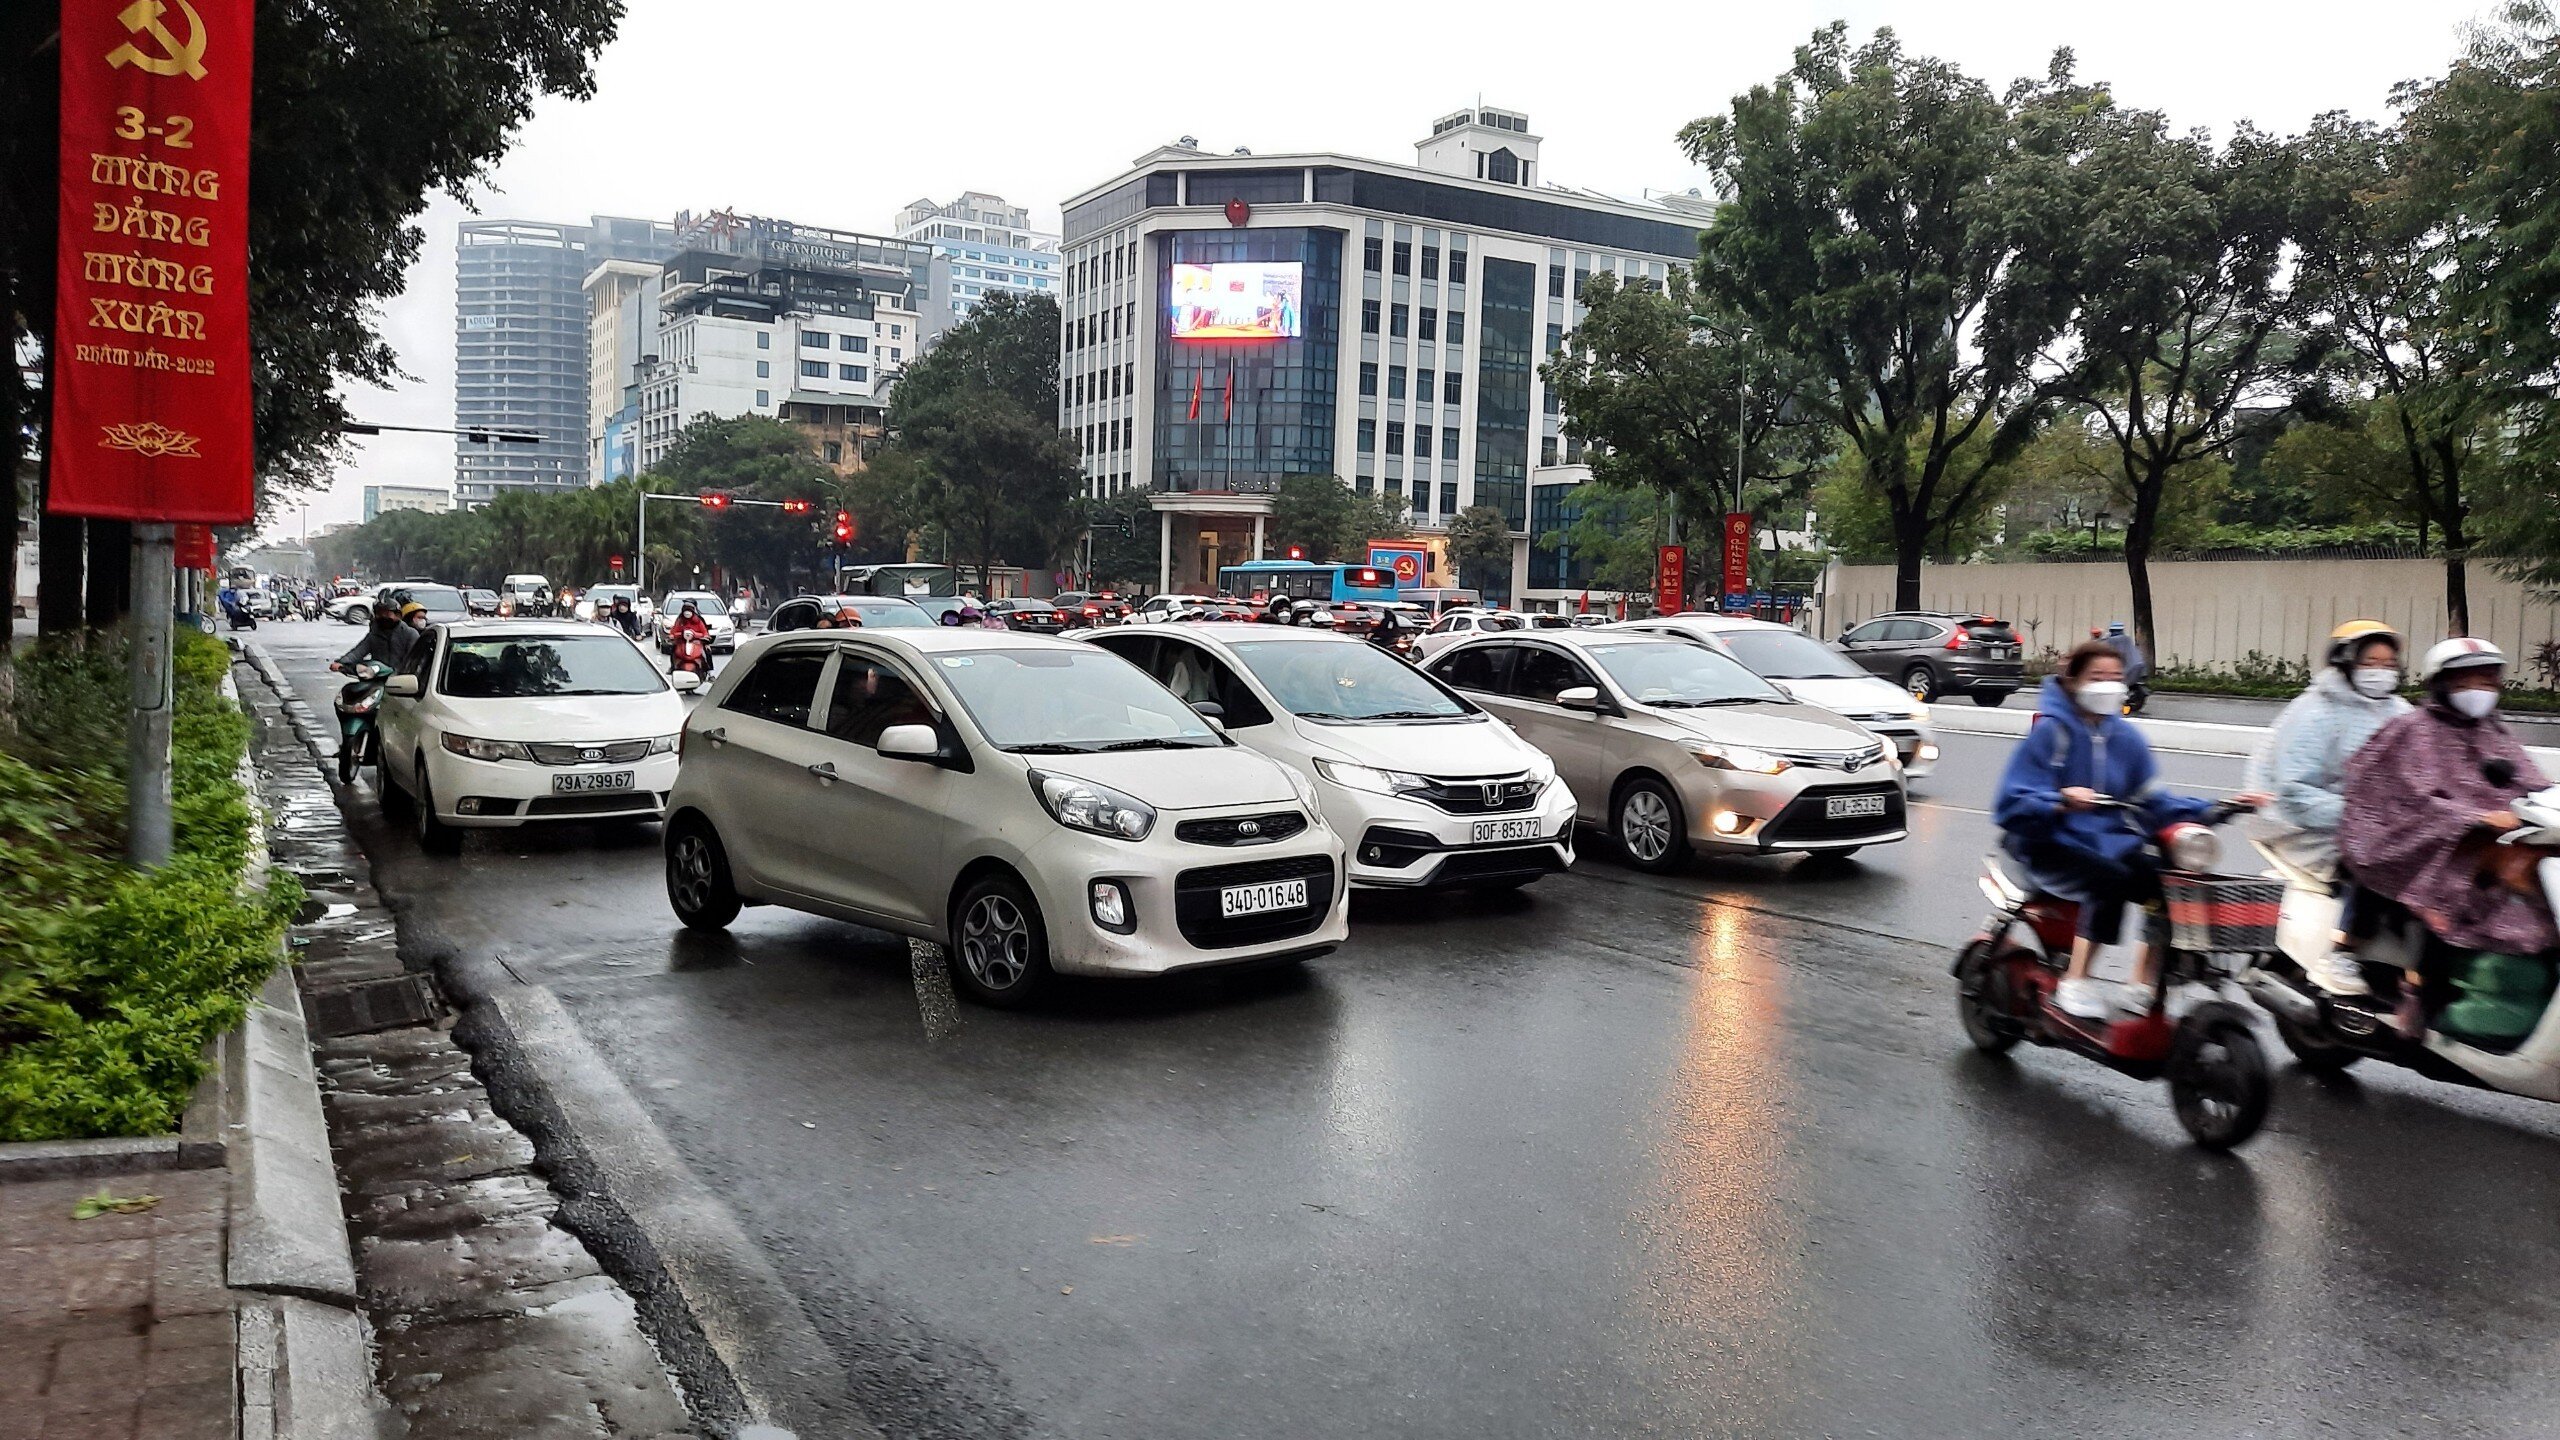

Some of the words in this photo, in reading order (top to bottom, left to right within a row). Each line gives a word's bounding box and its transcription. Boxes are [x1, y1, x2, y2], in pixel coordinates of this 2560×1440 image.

[115, 105, 194, 149] 3-2
[92, 195, 211, 247] ĐẢNG
[771, 240, 850, 261] GRANDIOSE
[88, 297, 206, 340] XUÂN
[75, 343, 130, 366] NHÂM
[556, 772, 632, 791] 29A-299.67
[1241, 822, 1259, 833] KIA
[1475, 820, 1539, 841] 30F-853.72
[1224, 882, 1305, 914] 34D-016.48
